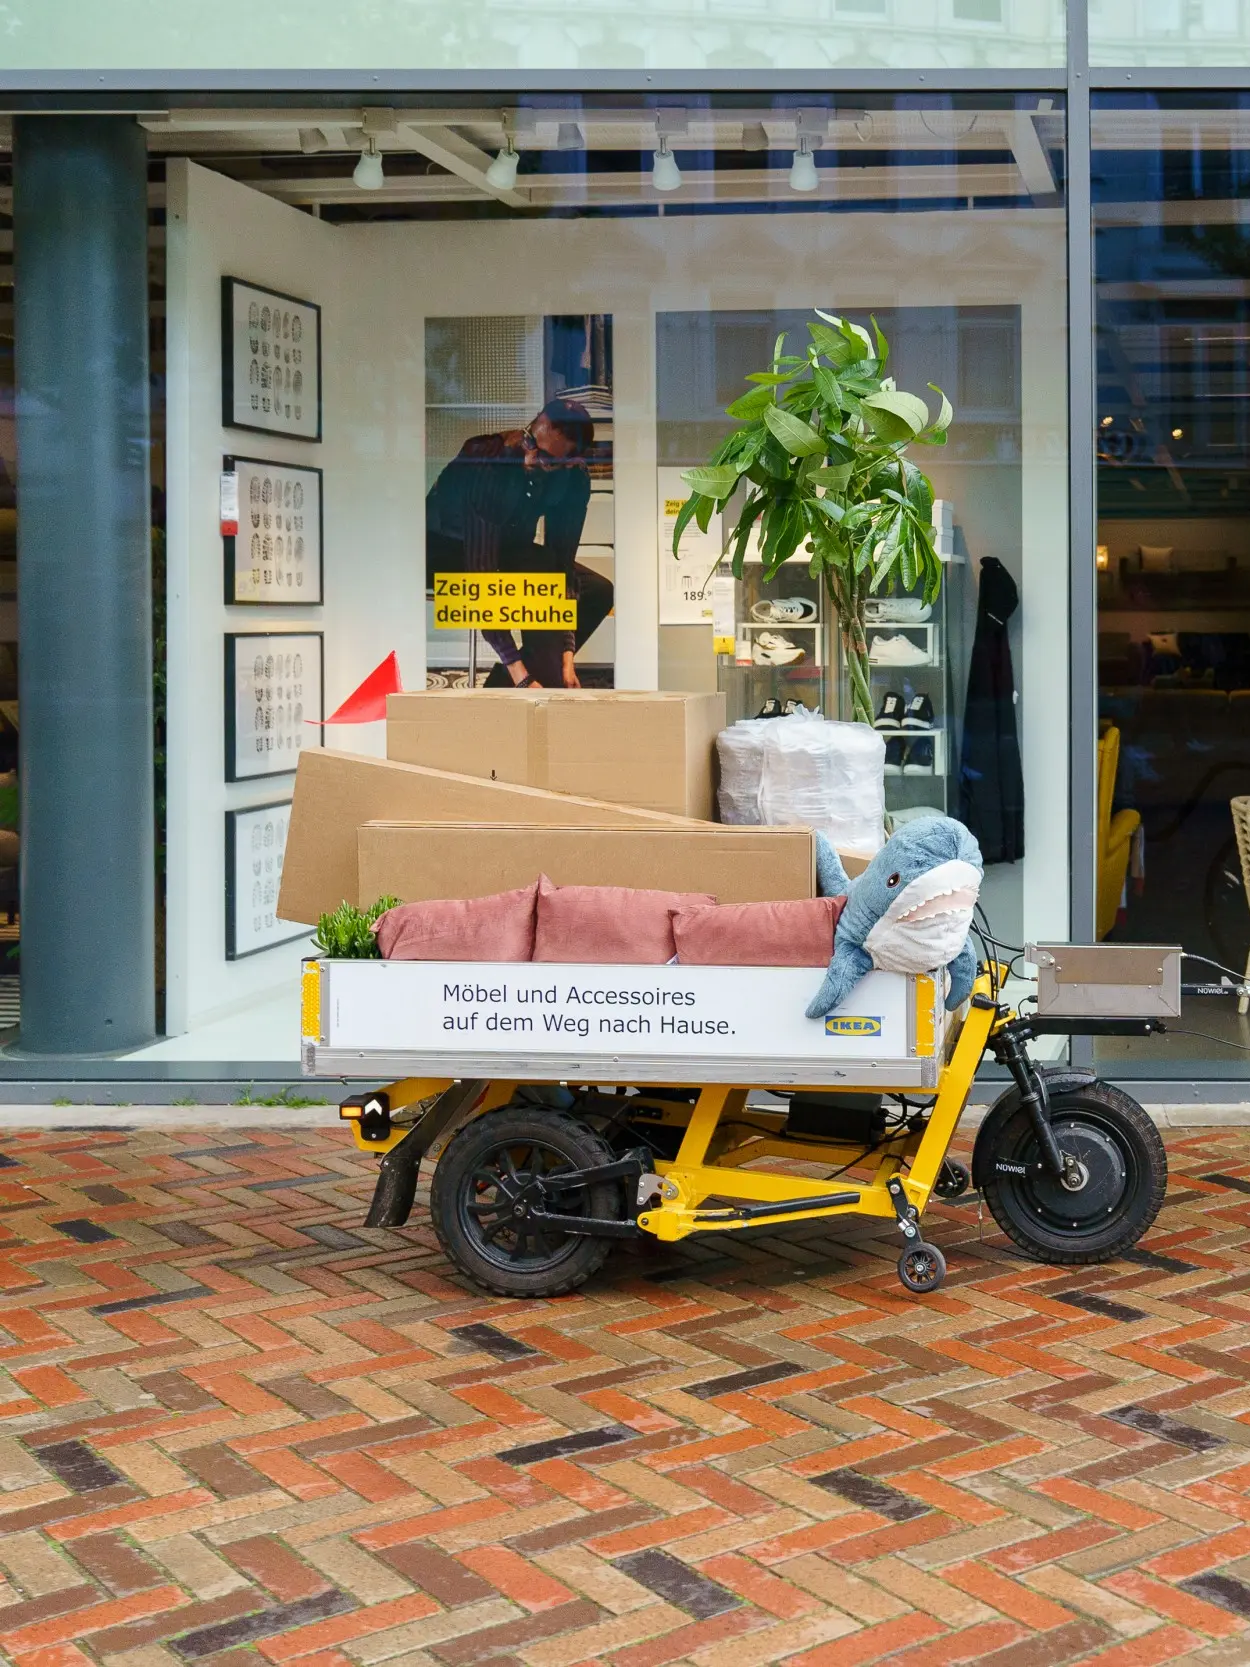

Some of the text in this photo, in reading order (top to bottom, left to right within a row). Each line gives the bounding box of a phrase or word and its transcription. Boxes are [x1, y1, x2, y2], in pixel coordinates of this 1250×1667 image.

[436, 579, 562, 601] Zeig sie her,
[436, 605, 574, 623] deine Schuhe
[443, 984, 696, 1006] Möbel und Accessoires
[443, 1012, 736, 1037] auf dem Weg nach Hause.
[832, 1021, 876, 1031] IKEA
